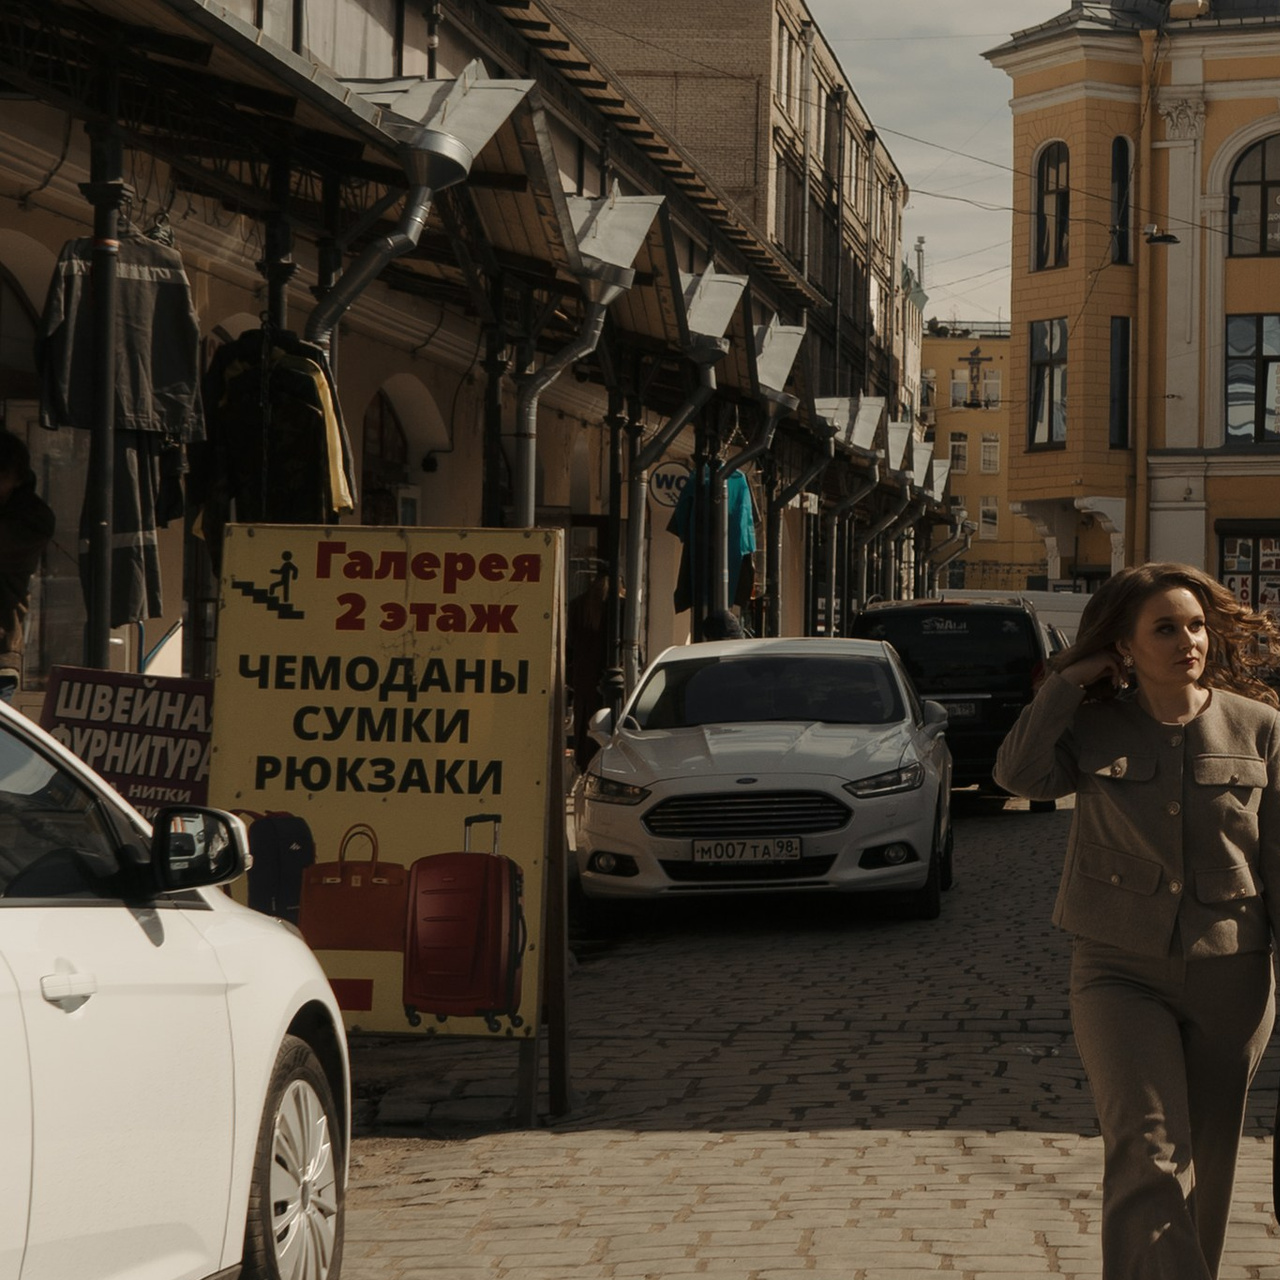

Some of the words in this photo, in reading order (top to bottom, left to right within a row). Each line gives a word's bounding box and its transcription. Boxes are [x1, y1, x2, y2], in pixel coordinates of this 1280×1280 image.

[315, 541, 541, 594] Галерея
[335, 593, 366, 631] 2
[379, 602, 519, 633] этаж
[238, 654, 529, 702] ЧЕМОДАНЫ
[54, 678, 213, 733] ШВЕЙНА
[292, 705, 470, 744] СУМКИ
[128, 783, 192, 803] НИТКИ
[254, 755, 503, 795] РЮКЗАКИ
[776, 840, 794, 854] 98
